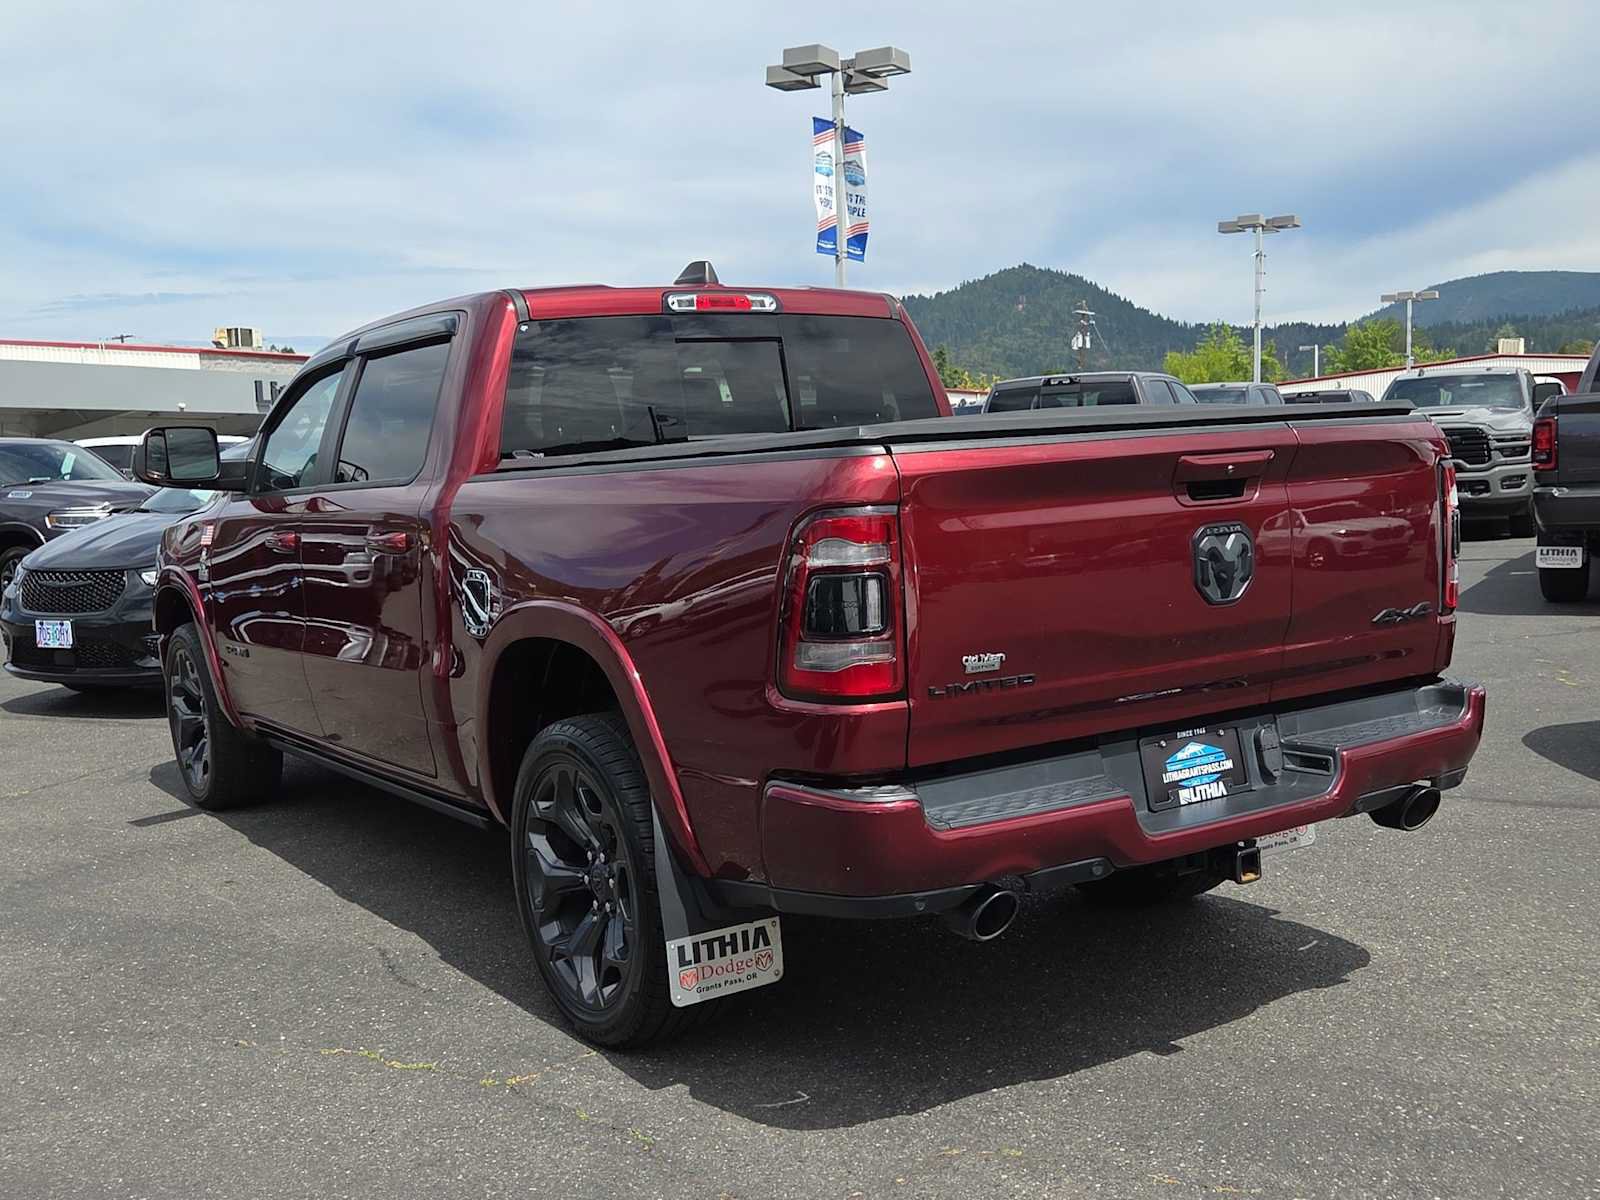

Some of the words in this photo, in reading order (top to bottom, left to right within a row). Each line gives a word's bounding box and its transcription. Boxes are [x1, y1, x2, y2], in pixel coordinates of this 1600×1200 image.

[1206, 524, 1242, 535] RAM
[1540, 548, 1577, 556] LITHIA
[928, 673, 1036, 698] LIMITED
[1176, 730, 1193, 739] SINCE
[1162, 759, 1234, 783] LITHIAGRANTSPASS.COM
[1189, 781, 1228, 802] LITHIA
[677, 925, 771, 969] LITHIA
[698, 956, 755, 980] Dodge
[696, 982, 722, 994] Grants
[724, 976, 745, 987] Pass,
[746, 972, 758, 982] OR
